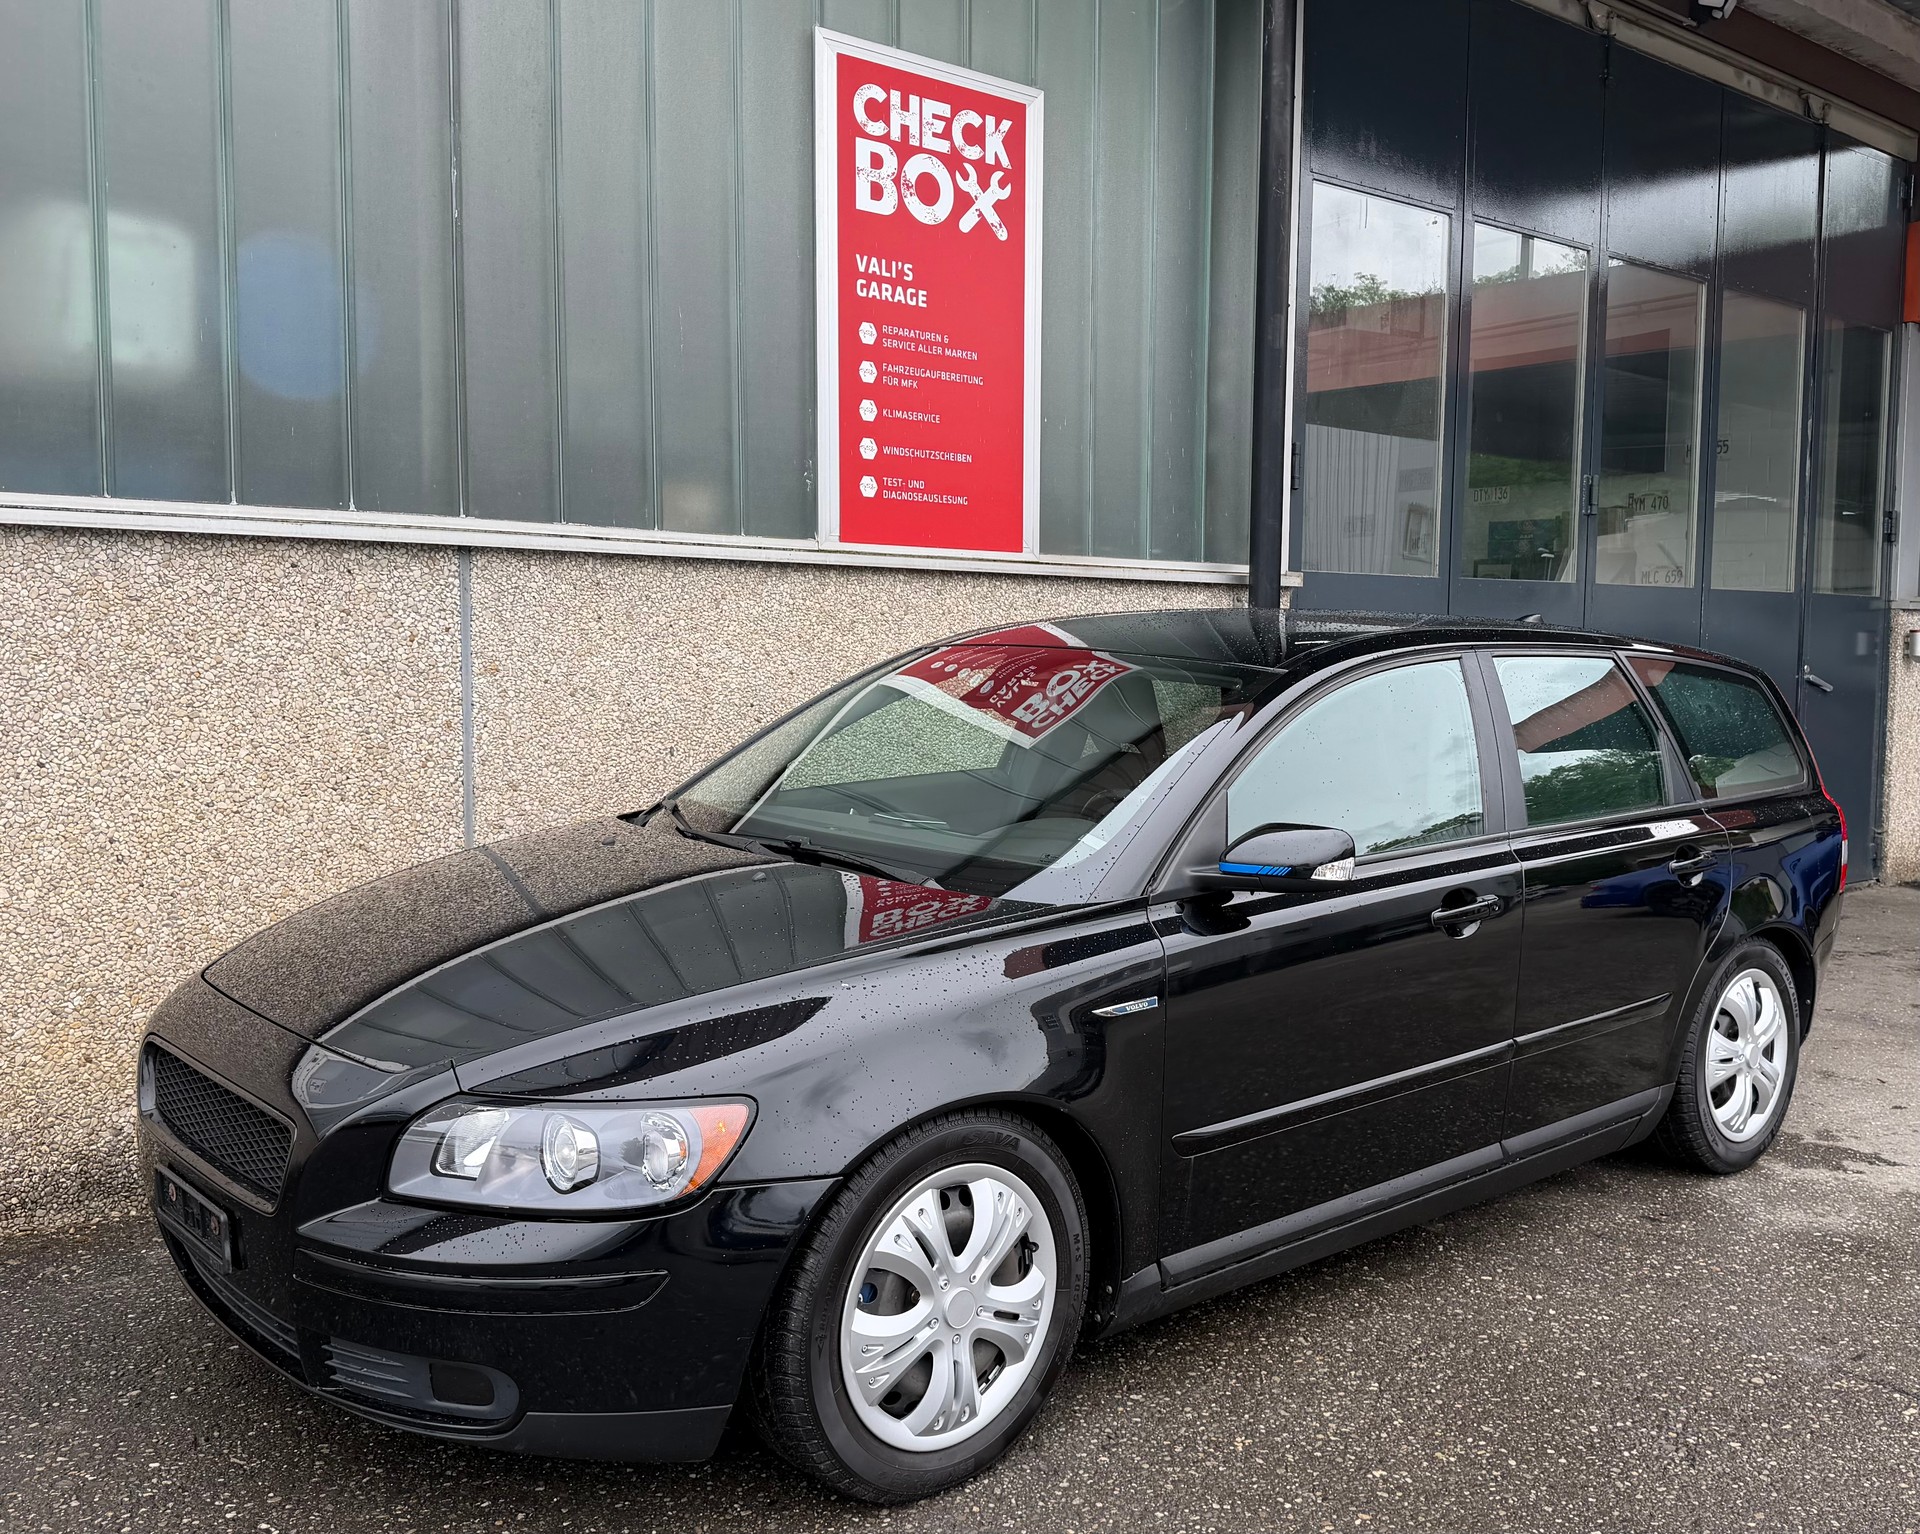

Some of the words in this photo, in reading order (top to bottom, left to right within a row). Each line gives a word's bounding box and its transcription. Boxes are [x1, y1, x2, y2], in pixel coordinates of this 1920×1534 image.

[853, 83, 1013, 170] CHECK
[856, 253, 914, 282] VALI'S
[856, 279, 928, 308] GARAGE
[882, 324, 942, 343] REPARATUREN
[943, 334, 950, 344] &
[882, 338, 916, 352] SERVICE
[917, 343, 943, 356] ALLER
[944, 346, 978, 361] MARKEN
[882, 362, 984, 386] FAHRZEUGAUFBEREITUNG
[882, 376, 899, 387] FÜR
[901, 379, 918, 390] MFK
[882, 408, 941, 424] KLIMASERVICE
[882, 445, 973, 463] WINDSCHUTZSCHEIBEN
[1716, 439, 1729, 454] 55
[882, 477, 906, 488] TEST-
[907, 480, 925, 490] UND
[882, 490, 968, 506] DIAGNOSEAUSLESUNG
[1494, 487, 1508, 500] 136
[1650, 495, 1669, 510] 470
[1125, 1001, 1148, 1011] VOLVO
